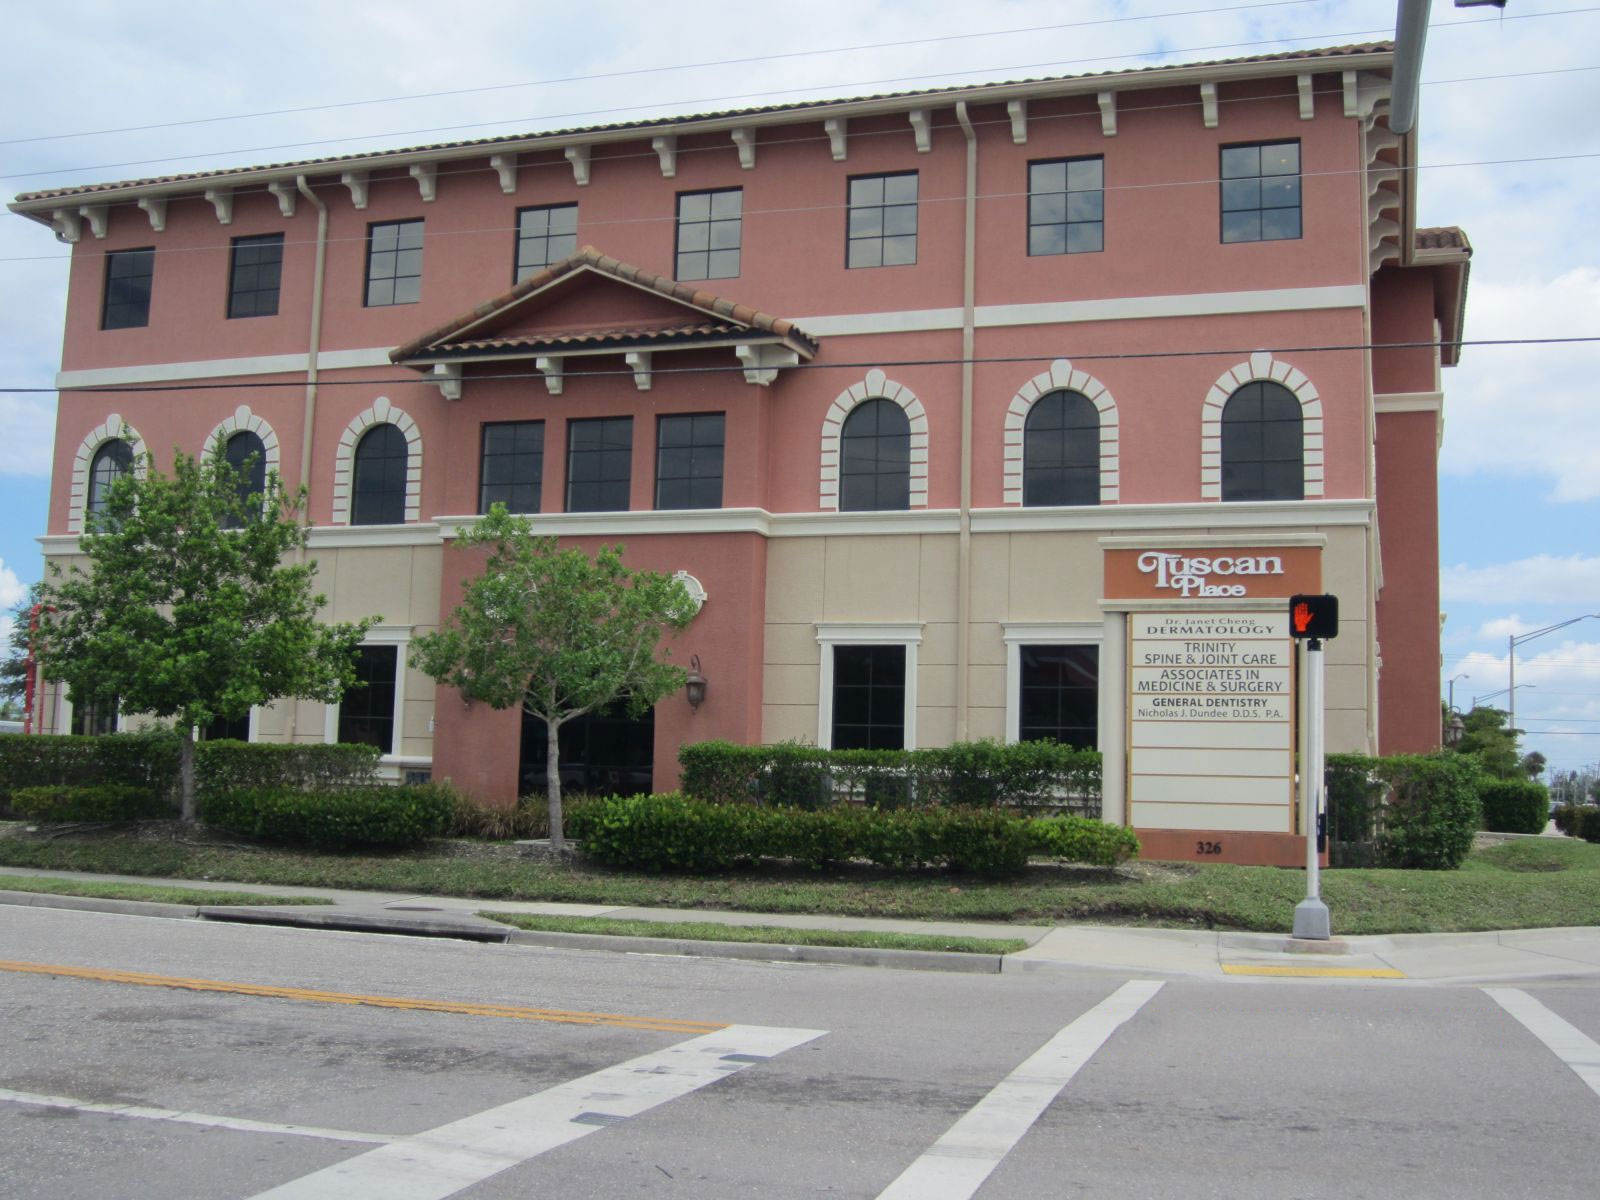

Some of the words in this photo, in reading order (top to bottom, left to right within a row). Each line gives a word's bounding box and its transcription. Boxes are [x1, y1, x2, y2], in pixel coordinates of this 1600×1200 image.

[1137, 551, 1285, 588] Tuscan
[1170, 575, 1247, 597] Place
[1218, 617, 1256, 626] Cheng
[1147, 626, 1275, 635] DERMATOLOGY
[1184, 642, 1236, 653] TRINITY
[1144, 653, 1182, 665] SPINE
[1186, 654, 1196, 665] &
[1199, 654, 1239, 665] JOINT
[1242, 654, 1277, 665] CARE
[1160, 669, 1241, 680] ASSOCIATES
[1246, 670, 1260, 680] IN
[1138, 681, 1202, 692] MEDICINE
[1206, 682, 1216, 692] &
[1220, 681, 1282, 693] SURGERY
[1152, 698, 1203, 707] GENERAL
[1206, 698, 1268, 708] DENTISTRY
[1138, 708, 1178, 718] Nicholas
[1180, 709, 1188, 718] J.
[1190, 709, 1228, 718] Dundee
[1232, 709, 1261, 719] D.D.S.
[1265, 709, 1283, 719] P.A.
[1196, 841, 1222, 855] 326
